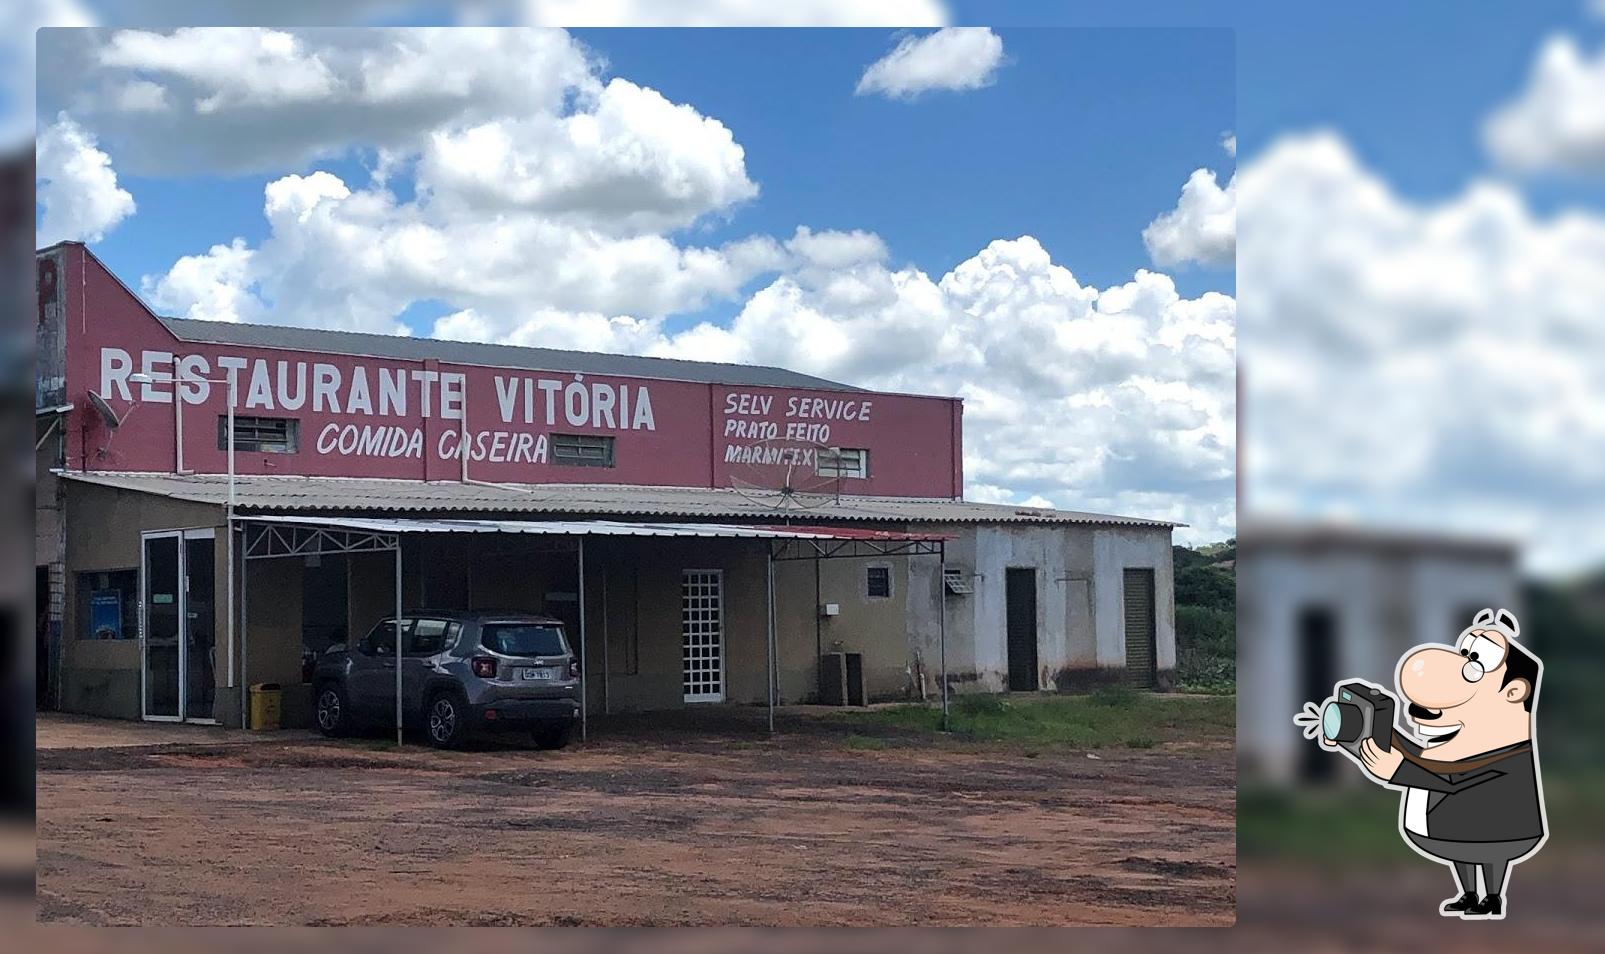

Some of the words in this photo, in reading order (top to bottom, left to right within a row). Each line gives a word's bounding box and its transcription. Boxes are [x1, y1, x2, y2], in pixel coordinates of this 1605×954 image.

[100, 347, 465, 419] RESTAURANTE
[494, 373, 656, 431] VITÓRIA
[724, 393, 773, 415] SELV
[785, 396, 873, 421] SERVICE
[316, 423, 424, 459] COMIDA
[438, 430, 548, 464] CASEIRA
[724, 419, 778, 440] PRATO
[786, 423, 830, 443] FEITO
